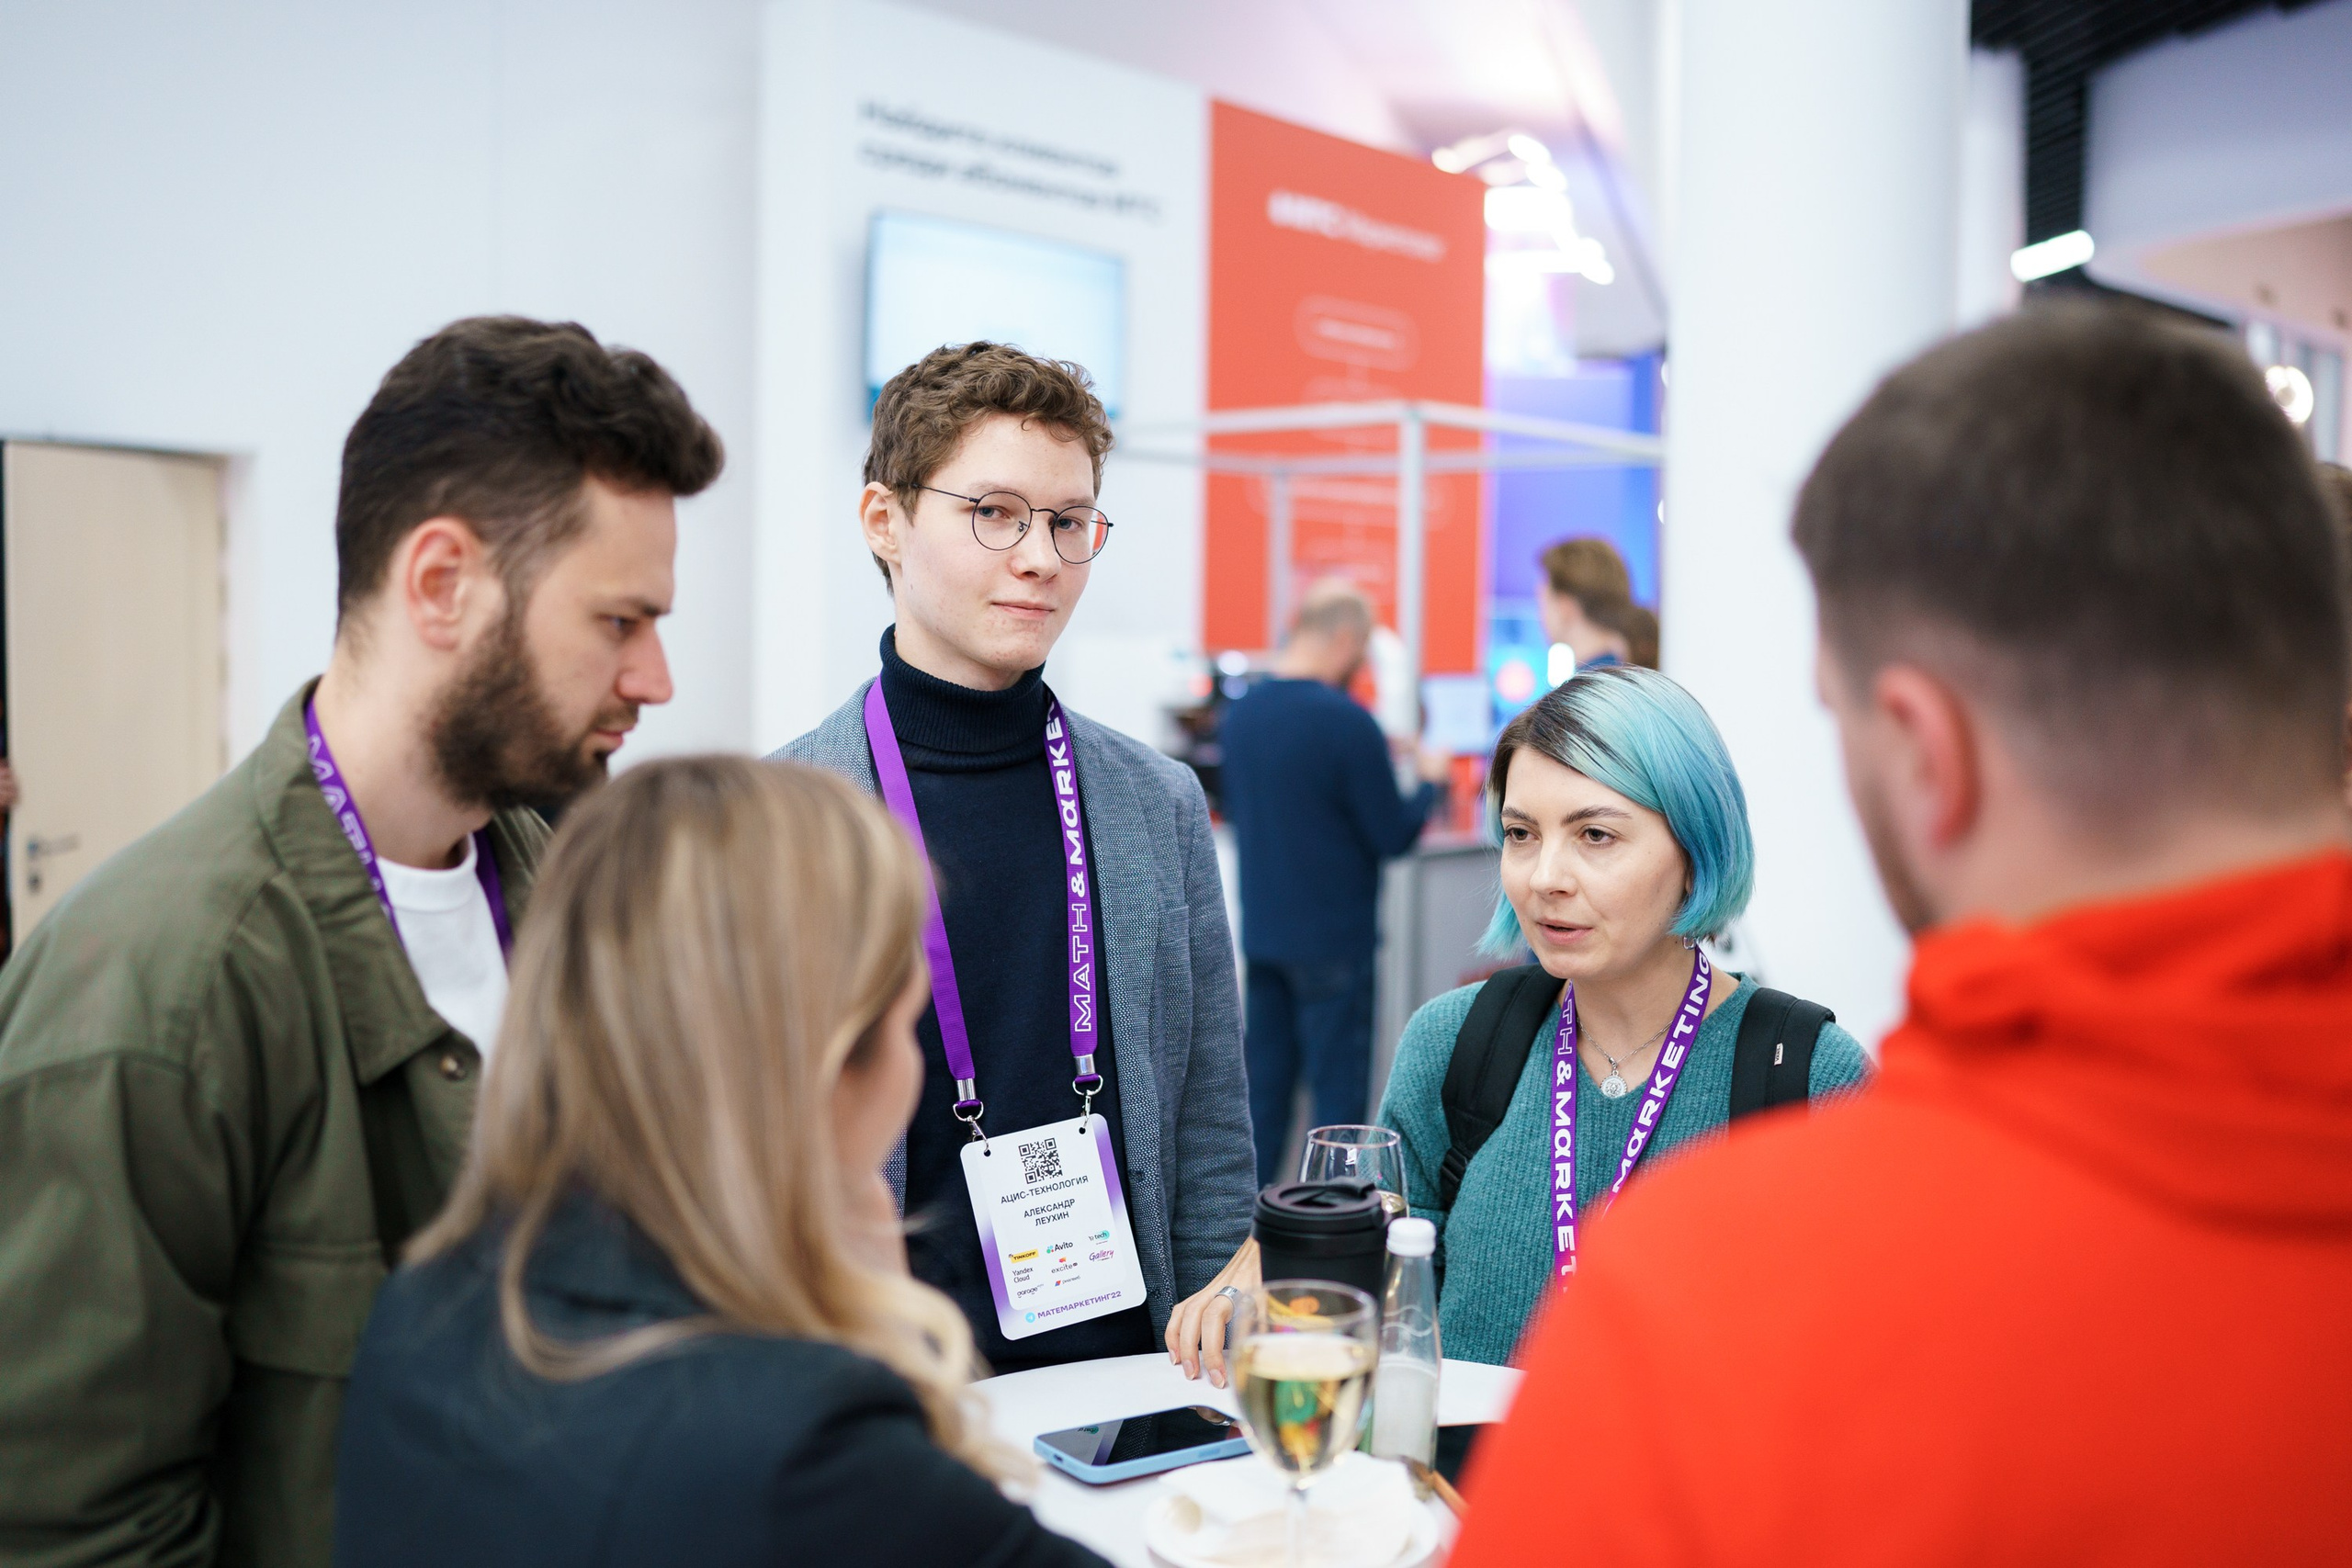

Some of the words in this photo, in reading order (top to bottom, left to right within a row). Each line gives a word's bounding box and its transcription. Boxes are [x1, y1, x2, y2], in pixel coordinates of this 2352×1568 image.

[1070, 871, 1086, 897] &
[1071, 903, 1091, 1032] MATH
[1555, 1060, 1572, 1088] &
[1001, 1175, 1089, 1204] АЦИС-ТЕХНОЛОГИЯ
[1023, 1198, 1076, 1218] АЛЕКСАНДР
[1035, 1211, 1069, 1226] ЛЕУХИН
[1094, 1231, 1107, 1241] tech
[1054, 1240, 1074, 1252] Avito
[1013, 1251, 1036, 1261] TINKOFF
[1089, 1249, 1114, 1262] Gallery
[1012, 1267, 1034, 1277] Yandex
[1051, 1263, 1073, 1274] excite
[1013, 1274, 1031, 1283] Cloud
[1017, 1286, 1038, 1298] garage
[1037, 1291, 1122, 1319] МАТЕМАРКЕТИНГ22
